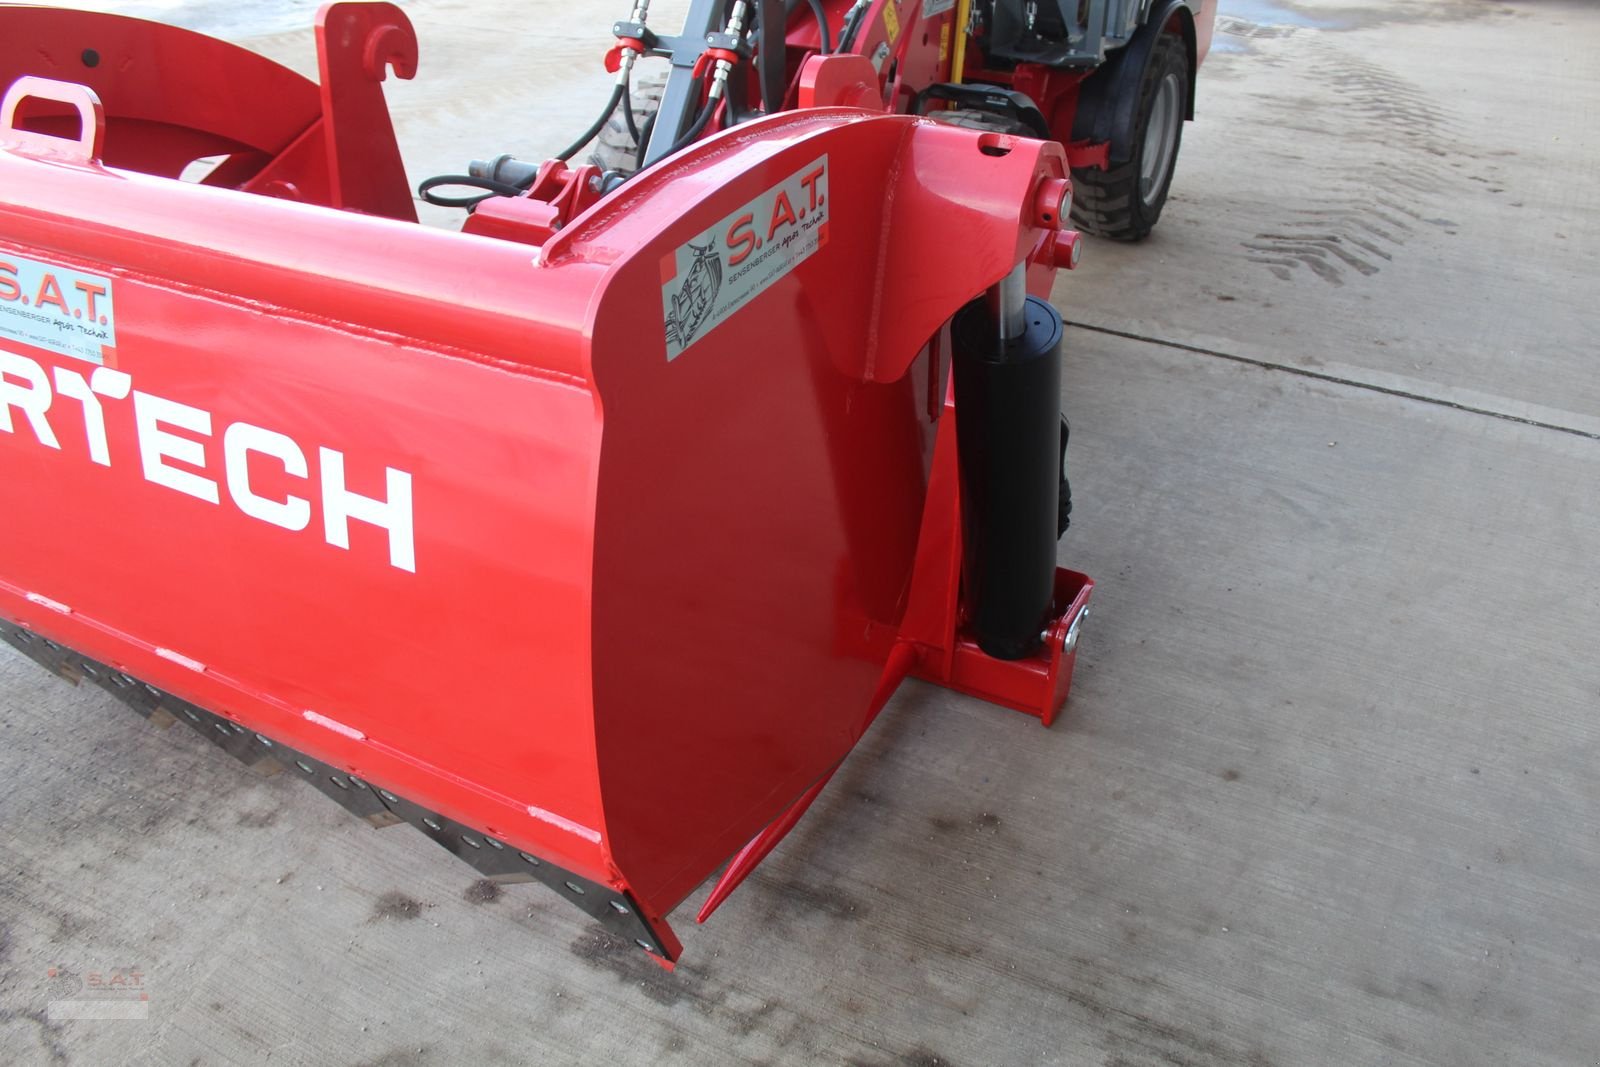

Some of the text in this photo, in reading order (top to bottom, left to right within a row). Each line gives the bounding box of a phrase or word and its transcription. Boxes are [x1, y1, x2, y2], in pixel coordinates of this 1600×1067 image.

[726, 164, 825, 267] S.A.T.
[0, 260, 108, 325] S.A.T.
[728, 242, 780, 285] SENSENBERGER
[77, 324, 109, 340] Technik
[0, 349, 416, 574] RTECH
